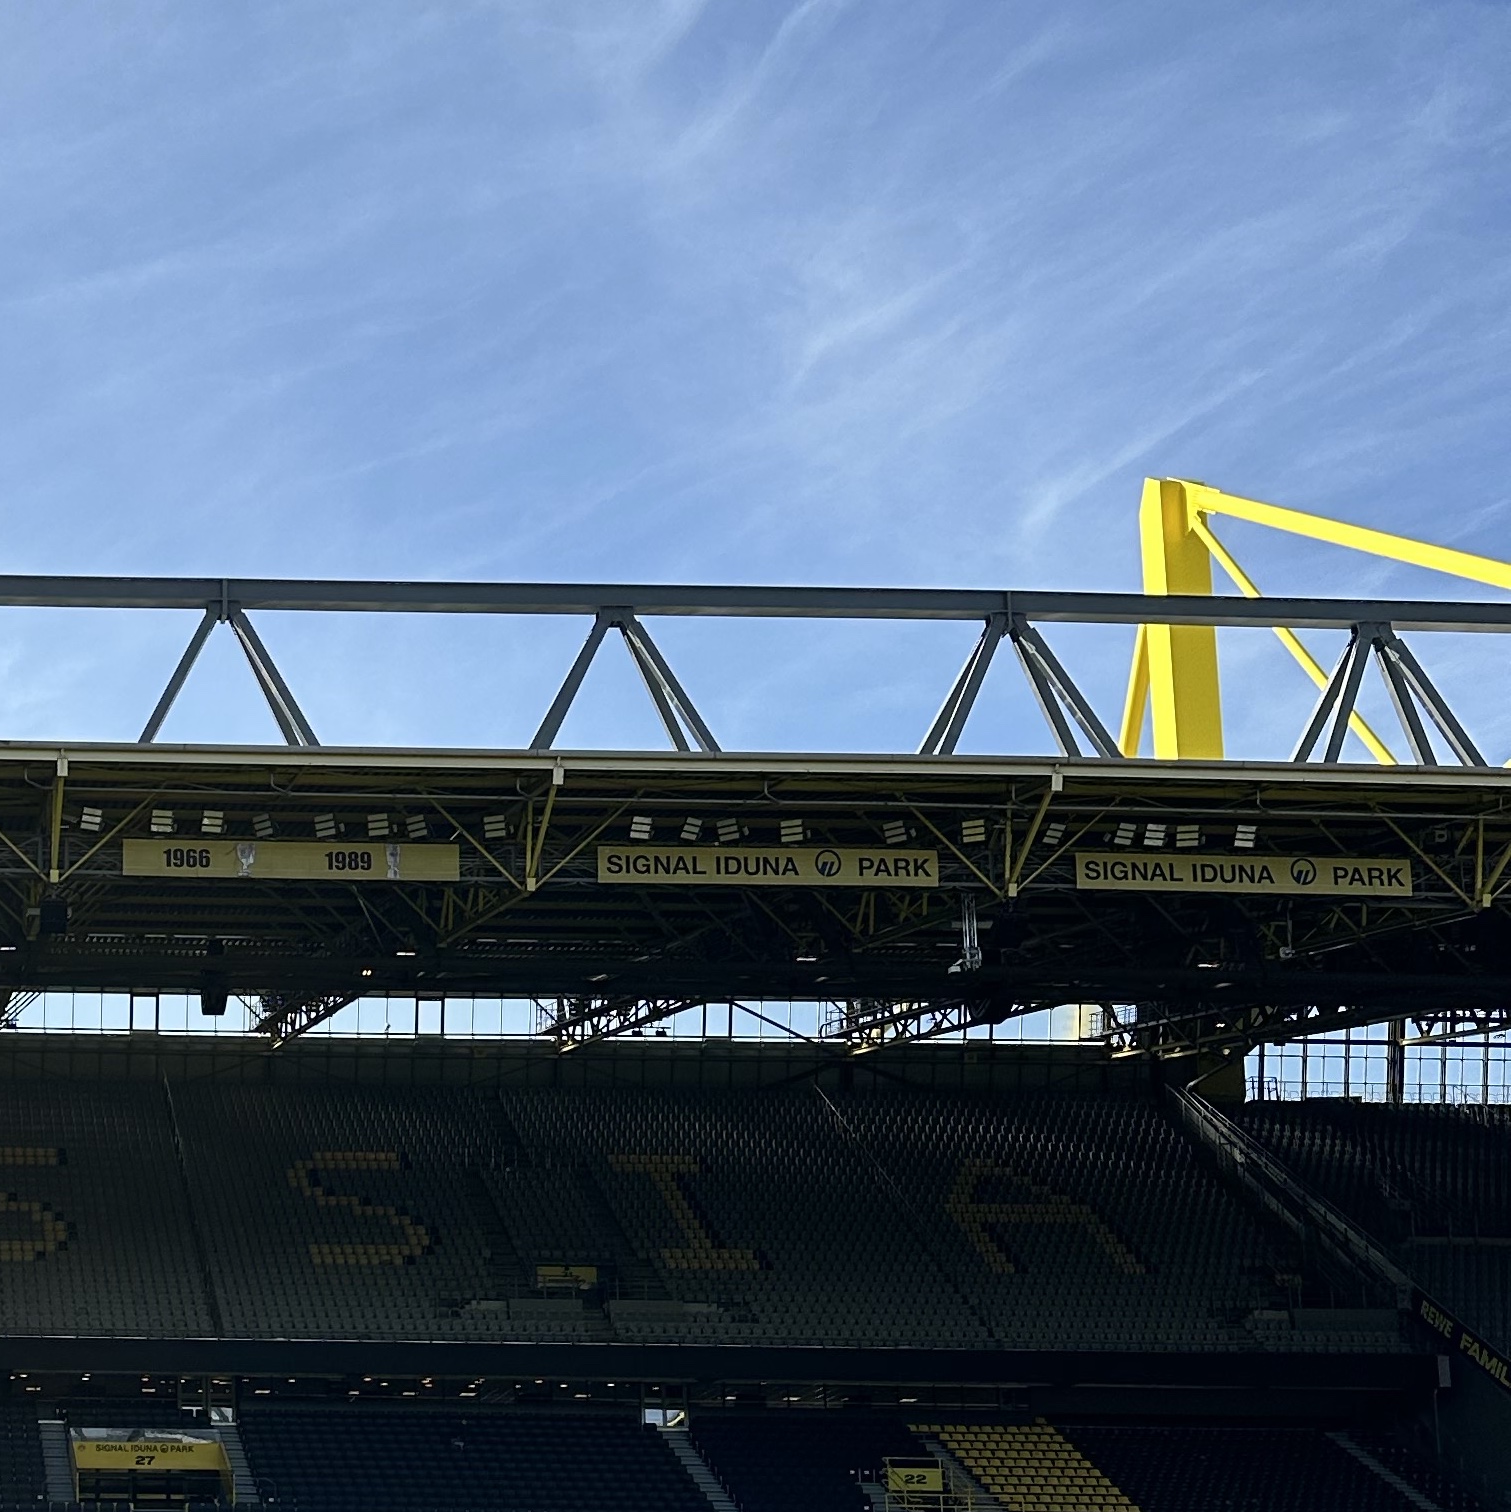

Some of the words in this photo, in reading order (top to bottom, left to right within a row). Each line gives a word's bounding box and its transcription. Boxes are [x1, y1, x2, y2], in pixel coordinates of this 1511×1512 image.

[162, 848, 211, 869] 1966
[324, 850, 373, 872] 1989
[606, 854, 707, 876] SIGNAL
[715, 856, 800, 877] IDUNA
[858, 857, 932, 878] PARK
[1084, 860, 1184, 883] SIGNAL
[1191, 863, 1275, 885] IDUNA
[1333, 866, 1405, 888] PARK
[1420, 1299, 1454, 1339] REWE
[1459, 1331, 1511, 1389] FAMIL
[95, 1443, 128, 1452] SIGNAL
[130, 1444, 158, 1453] IDUNA
[170, 1445, 195, 1453] PARK
[135, 1455, 156, 1466] 27
[904, 1474, 928, 1485] 22
